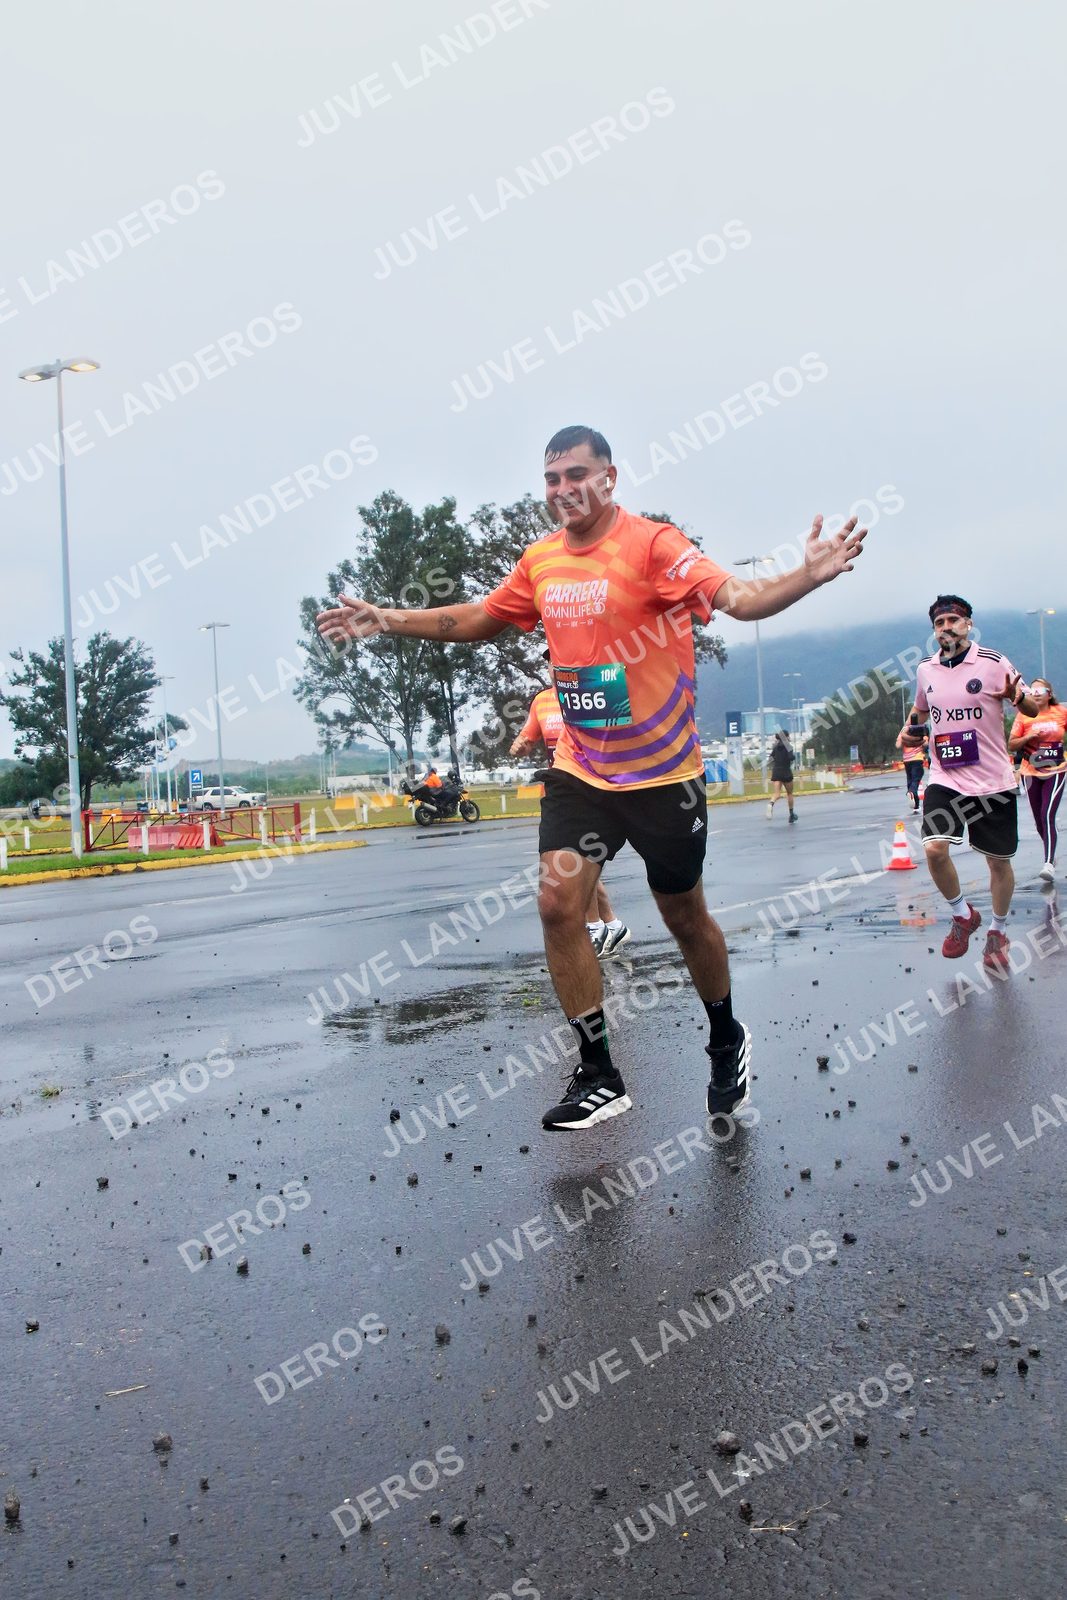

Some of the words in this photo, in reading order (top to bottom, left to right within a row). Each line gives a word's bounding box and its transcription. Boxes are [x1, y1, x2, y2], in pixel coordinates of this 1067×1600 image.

[545, 579, 608, 603] CARRERA
[544, 603, 592, 618] OMNILIFE
[600, 668, 617, 682] 10K
[564, 692, 606, 710] 1366
[946, 707, 982, 721] XBTO
[729, 722, 738, 734] E
[942, 746, 962, 758] 253
